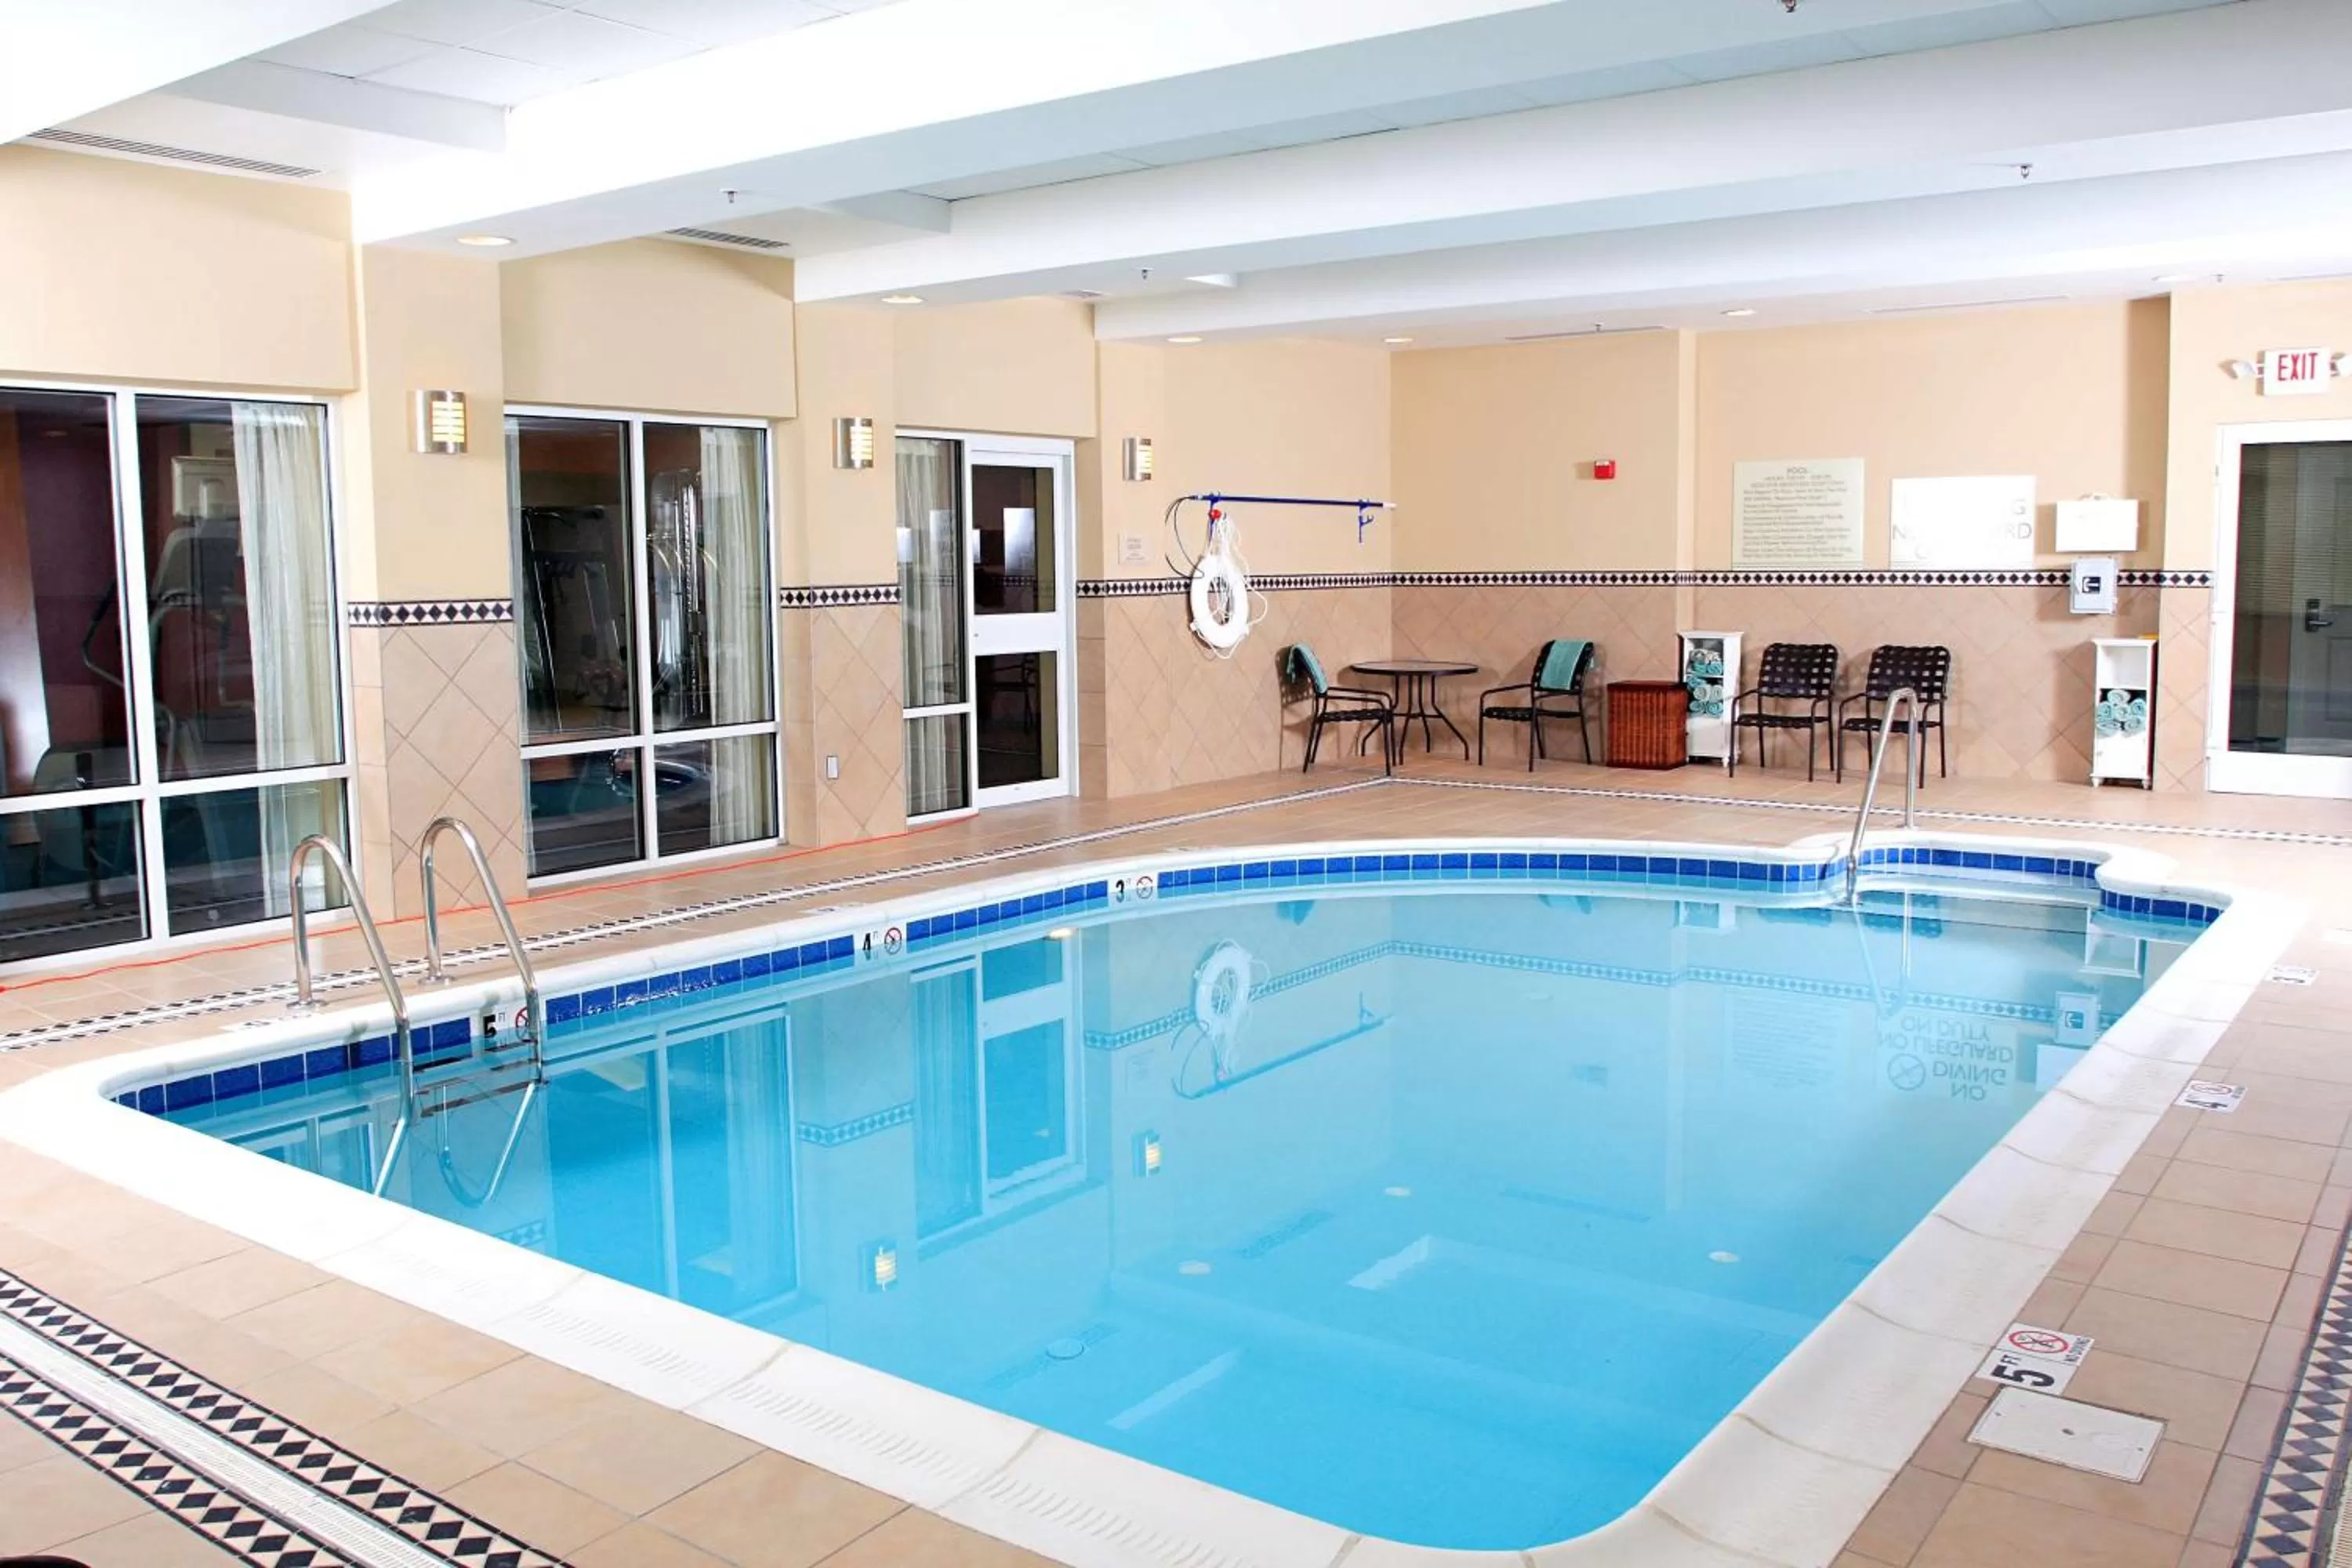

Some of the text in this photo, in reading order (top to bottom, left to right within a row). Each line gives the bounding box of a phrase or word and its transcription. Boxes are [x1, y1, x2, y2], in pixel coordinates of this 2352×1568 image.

[2278, 352, 2318, 381] EXIT
[483, 1014, 496, 1038] 5
[1990, 1354, 2055, 1387] 5 FT
